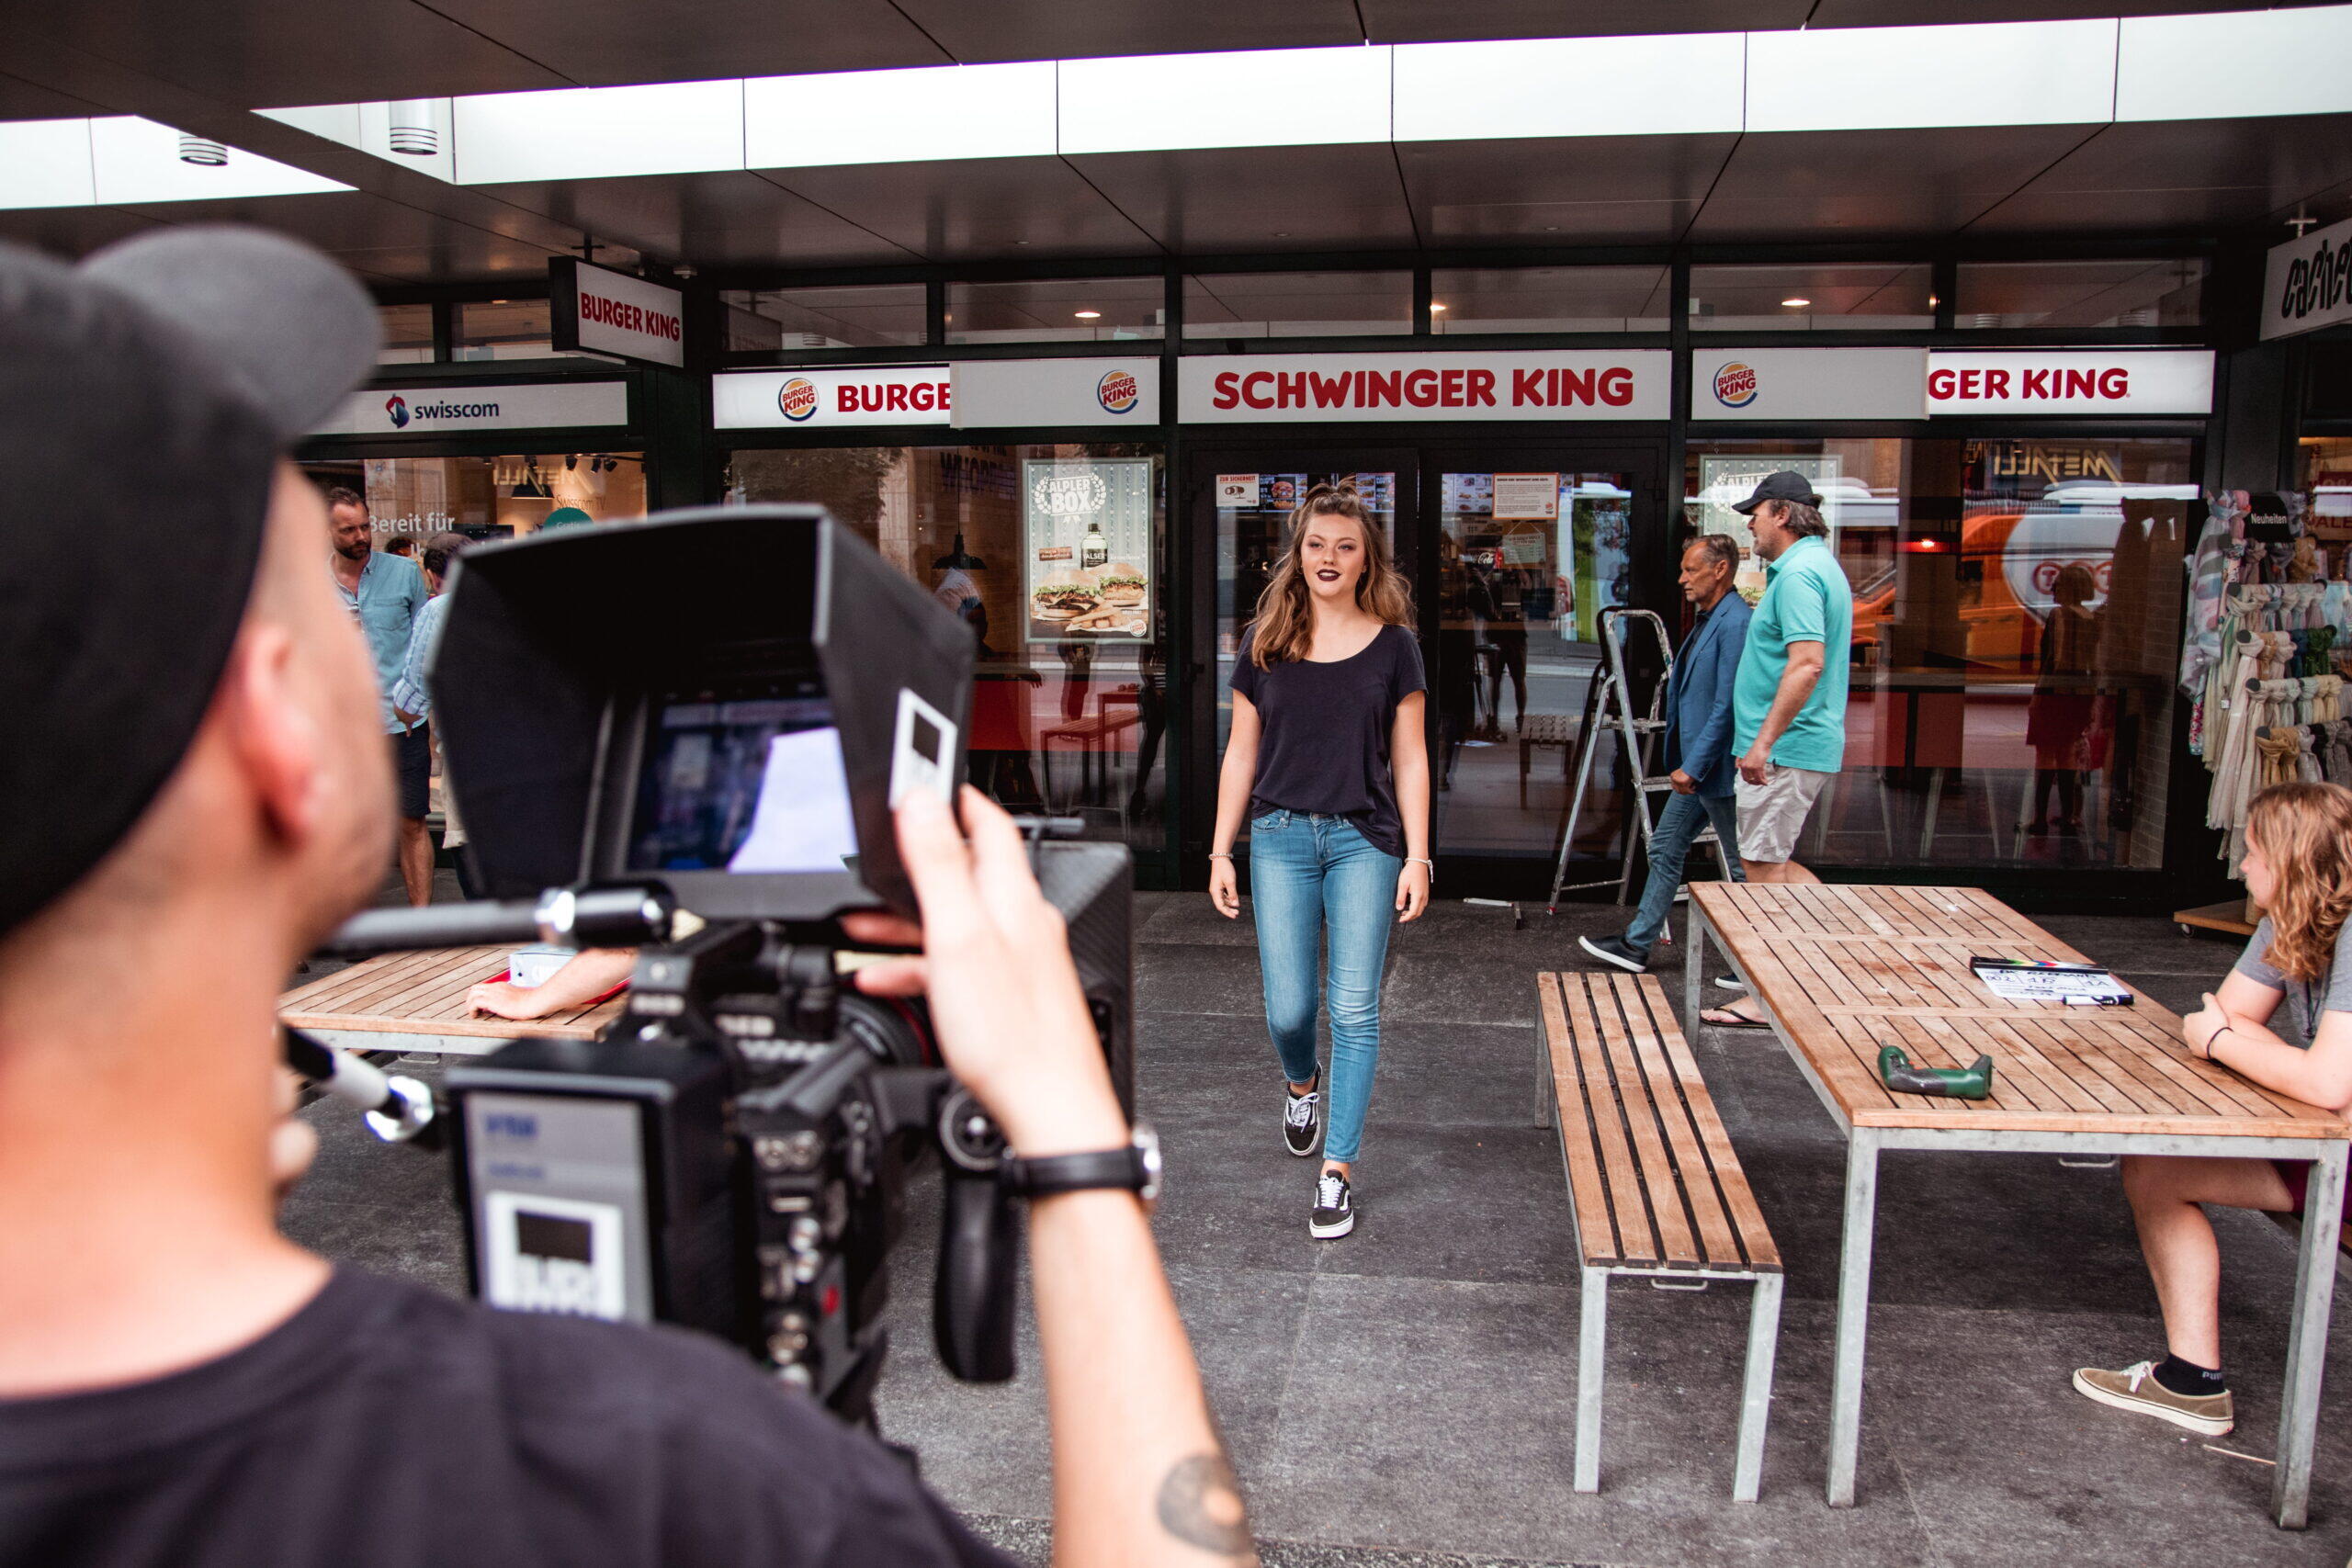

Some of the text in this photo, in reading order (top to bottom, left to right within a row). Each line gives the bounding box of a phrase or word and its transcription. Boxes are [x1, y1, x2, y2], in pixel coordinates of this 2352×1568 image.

[581, 292, 681, 343] BURGER KING
[1102, 377, 1136, 395] BURGER
[1212, 367, 1634, 411] SCHWINGER KING
[1717, 369, 1755, 388] BURGER
[1719, 378, 1757, 399] KING
[1928, 367, 2129, 400] GER KING
[782, 385, 814, 402] BURGER
[783, 393, 816, 414] KING
[837, 382, 951, 412] BURGE
[1102, 385, 1137, 406] KING
[414, 400, 500, 420] swisscom
[1048, 479, 1091, 493] ALPLER
[1050, 491, 1093, 513] BOX
[426, 512, 456, 531] für
[2250, 513, 2288, 525] Neuheiten
